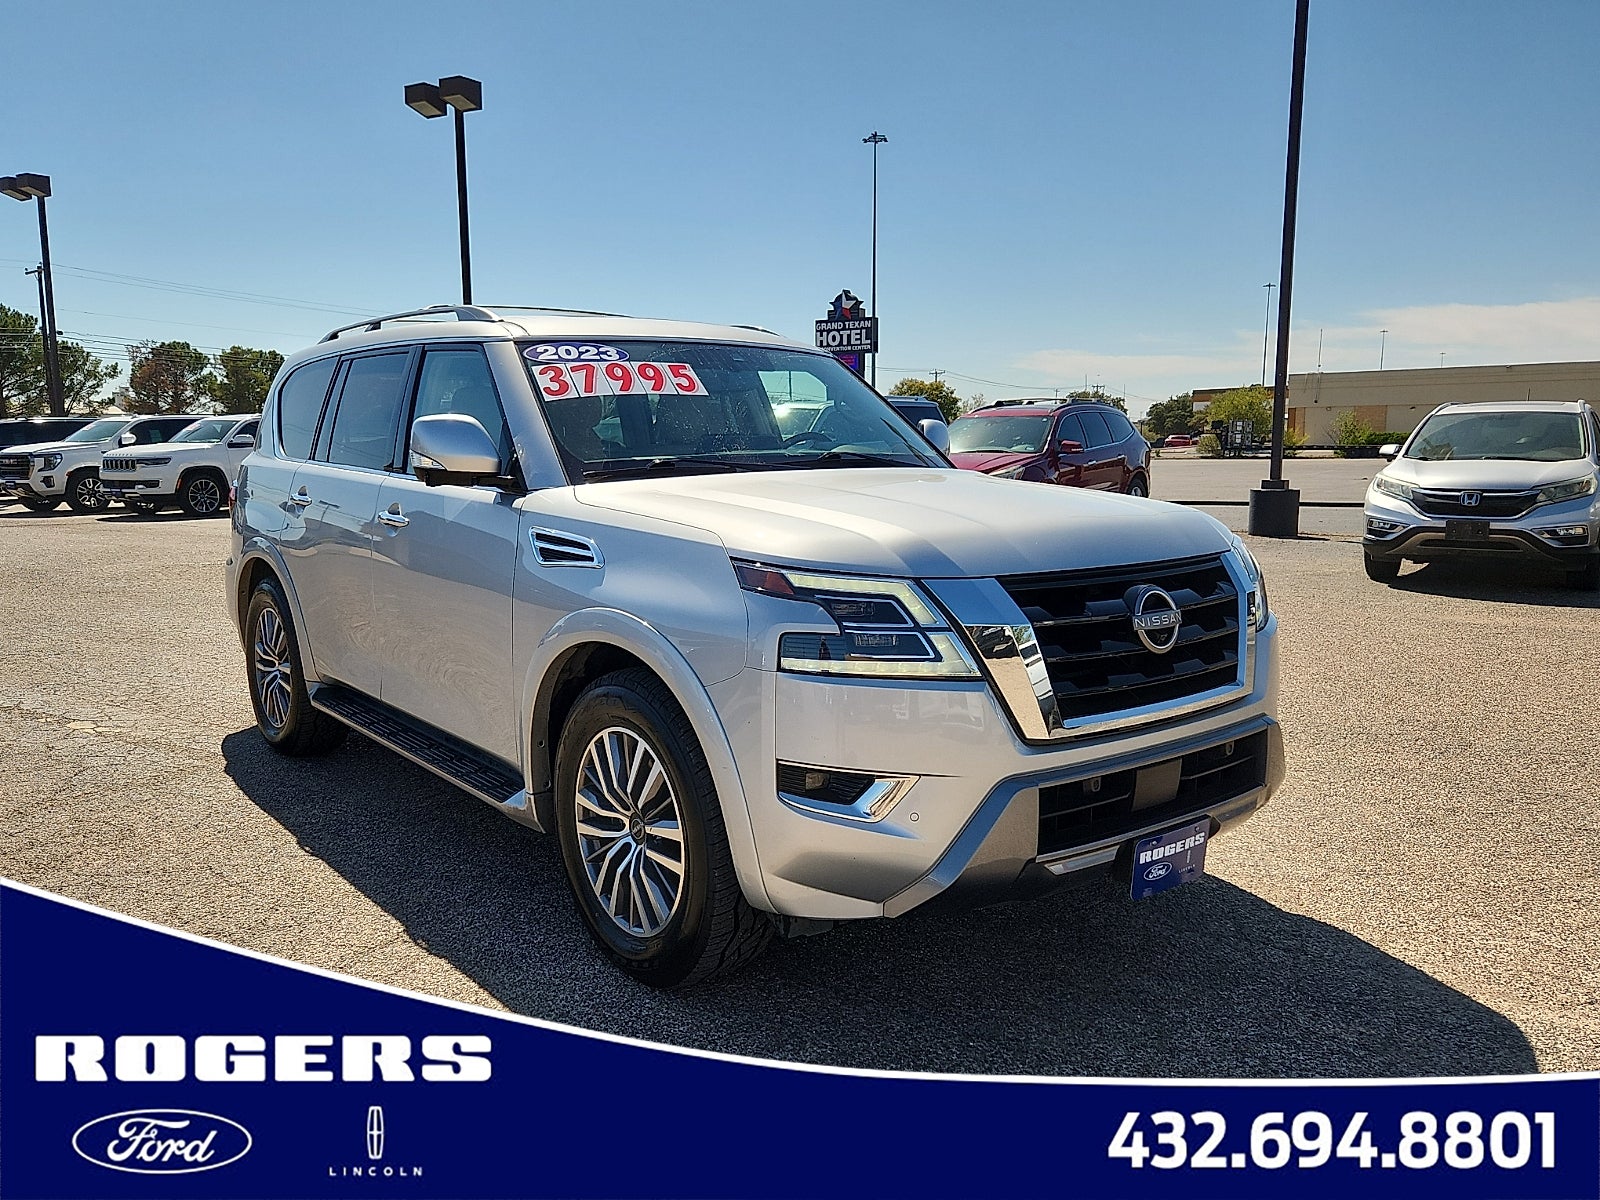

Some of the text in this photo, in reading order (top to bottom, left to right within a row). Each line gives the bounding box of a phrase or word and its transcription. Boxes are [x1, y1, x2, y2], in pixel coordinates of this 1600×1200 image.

[816, 320, 871, 331] GRAND TEXAN
[816, 329, 871, 346] HOTEL
[536, 345, 620, 361] 2023
[538, 363, 698, 397] 37995
[1134, 613, 1182, 628] NISSAN
[1139, 832, 1206, 865] ROGERS
[1148, 865, 1168, 879] Ford
